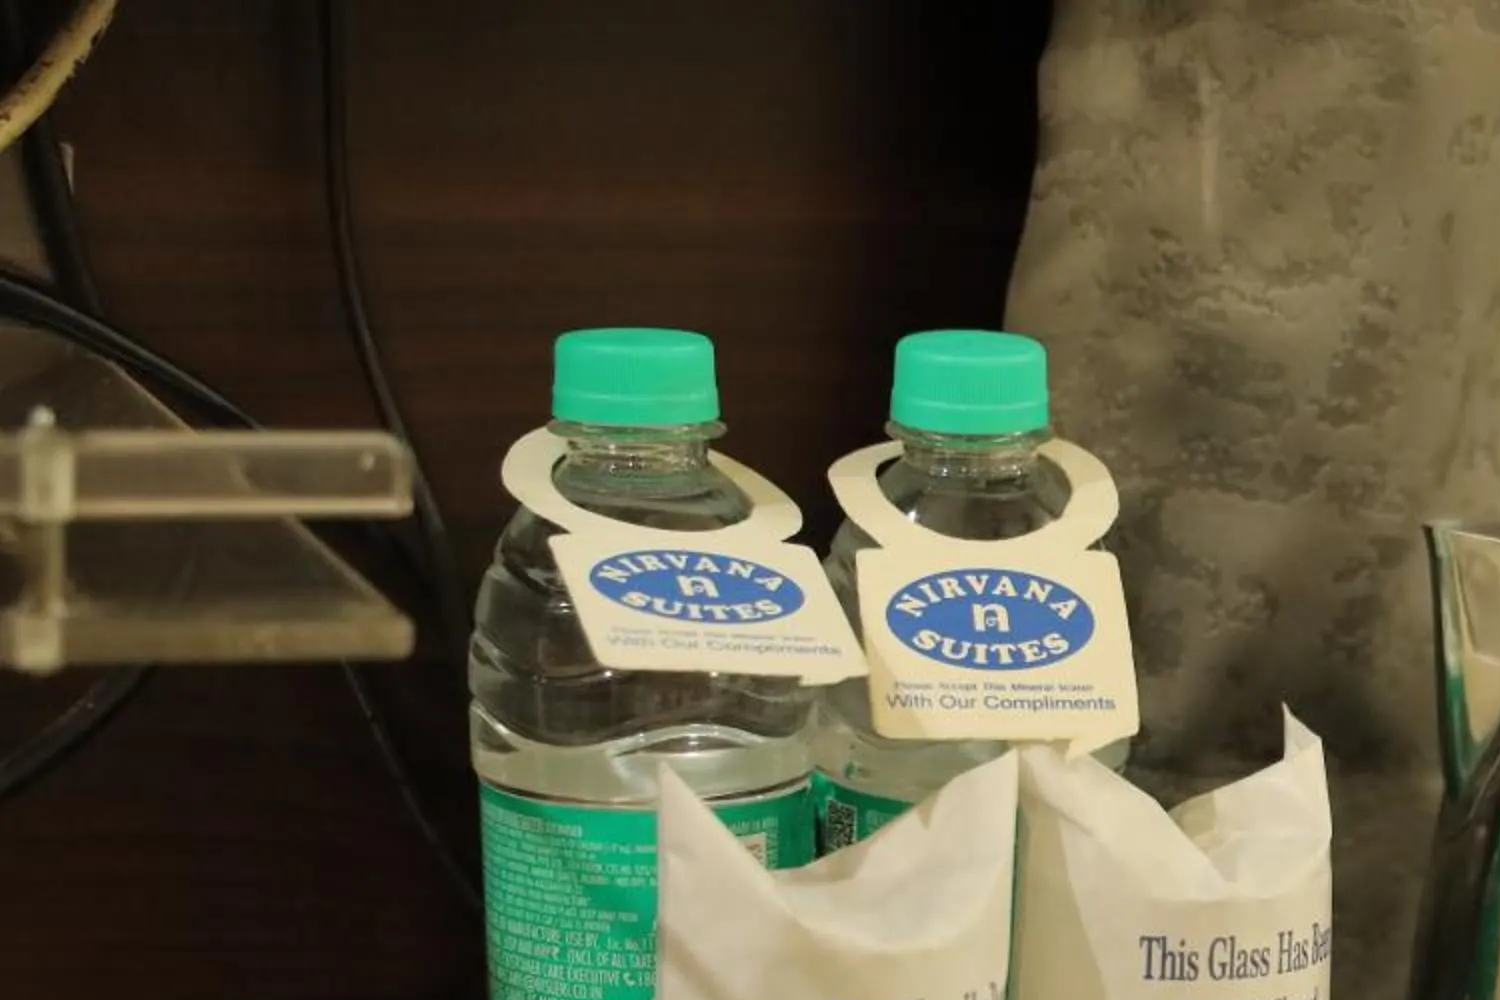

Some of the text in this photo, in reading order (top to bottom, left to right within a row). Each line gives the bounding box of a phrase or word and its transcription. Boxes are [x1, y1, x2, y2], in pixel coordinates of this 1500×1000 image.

[597, 553, 785, 592] NIRVANA
[620, 591, 784, 620] SUITES
[895, 573, 1079, 620] NIRVANA
[911, 628, 1069, 665] SUITES
[885, 693, 1117, 712] With Our Compliments
[1139, 935, 1199, 982] This
[1207, 935, 1271, 981] Glass
[1276, 930, 1309, 974] Has
